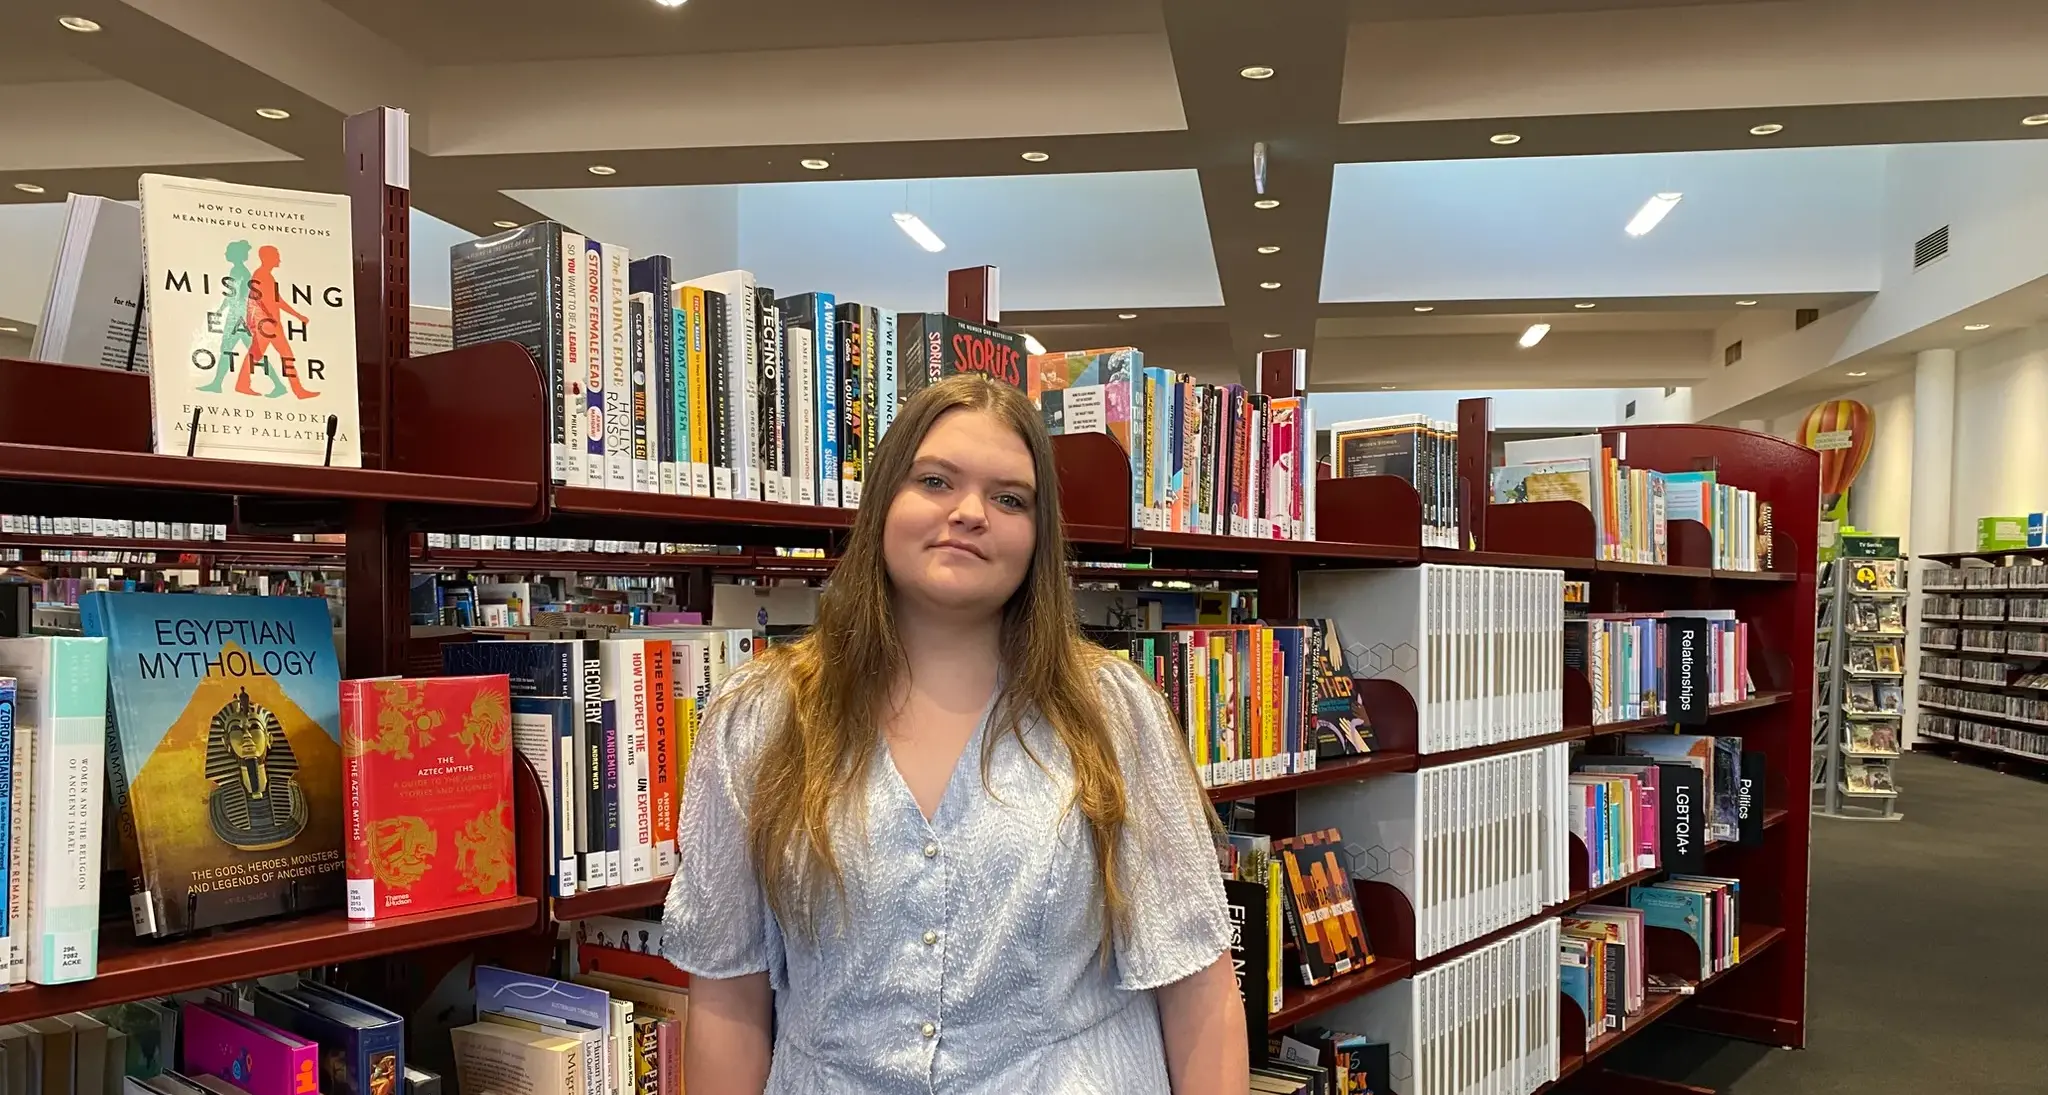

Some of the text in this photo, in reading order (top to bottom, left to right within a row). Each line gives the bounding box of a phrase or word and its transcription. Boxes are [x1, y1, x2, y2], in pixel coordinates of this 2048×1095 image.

[173, 214, 331, 236] MEANINGFUL CONNECTIONS
[199, 203, 224, 211] HOW
[248, 209, 305, 221] CULTIVATE
[568, 244, 576, 256] SO
[568, 258, 576, 274] YOU
[165, 269, 343, 307] MISSING
[568, 276, 576, 299] WANT
[568, 301, 576, 311] TO
[569, 312, 576, 323] BE
[589, 254, 600, 388] STRONG FEMALE LEAD
[611, 255, 624, 387] The LEADING EDGE
[887, 316, 892, 327] IF
[207, 312, 308, 342] EACH
[556, 324, 562, 335] IN
[635, 313, 643, 336] CLEO
[663, 324, 669, 335] ON
[744, 285, 754, 365] Pure Human
[886, 330, 892, 346] WE
[569, 332, 577, 363] LEADER
[763, 306, 775, 379] TECHNO
[852, 322, 861, 366] LEAD
[929, 331, 942, 377] STORIES
[192, 349, 325, 380] OTHER
[677, 313, 687, 431] EVERYDAY ACTIVISM
[824, 301, 836, 442] A WORLD WITHOUT WORK
[264, 411, 327, 423] BRODKI
[556, 405, 563, 420] OF
[618, 402, 630, 456] HOLLY
[635, 391, 646, 435] WHERE TO
[853, 401, 861, 437] WAY
[252, 427, 348, 442] PALLATHA
[867, 414, 875, 449] LOUISA
[155, 618, 295, 647] EGYPTIAN
[138, 650, 316, 680] MYTHOLOGY
[1679, 630, 1694, 710] Relationships
[584, 659, 602, 724] RECOVERY
[633, 653, 645, 752] HOW TO EXPECT THE
[655, 650, 667, 784] THE END OF WOKE
[0, 708, 10, 798] ZOROASTRIANISM
[606, 730, 615, 780] PANDEMIC!
[418, 764, 474, 776] AZTEC MYTHS
[67, 758, 77, 855] OF ANCIENT ISRAEL
[351, 779, 359, 808] AZTEC
[1739, 778, 1752, 819] Politics
[78, 758, 88, 891] WOMEN AND THE RELIGION
[352, 809, 361, 841] MYTHS
[638, 778, 648, 844] UN EXPECTED
[1676, 786, 1689, 855] LGBTQIA+
[11, 747, 23, 920] THE BEAUTY OF WHAT REMAINS
[188, 861, 345, 894] AND LEGENDS OF ANCIENT EGYPT
[192, 850, 338, 880] THE GODS, HEROES, MONSTERS
[644, 1029, 657, 1062] THE
